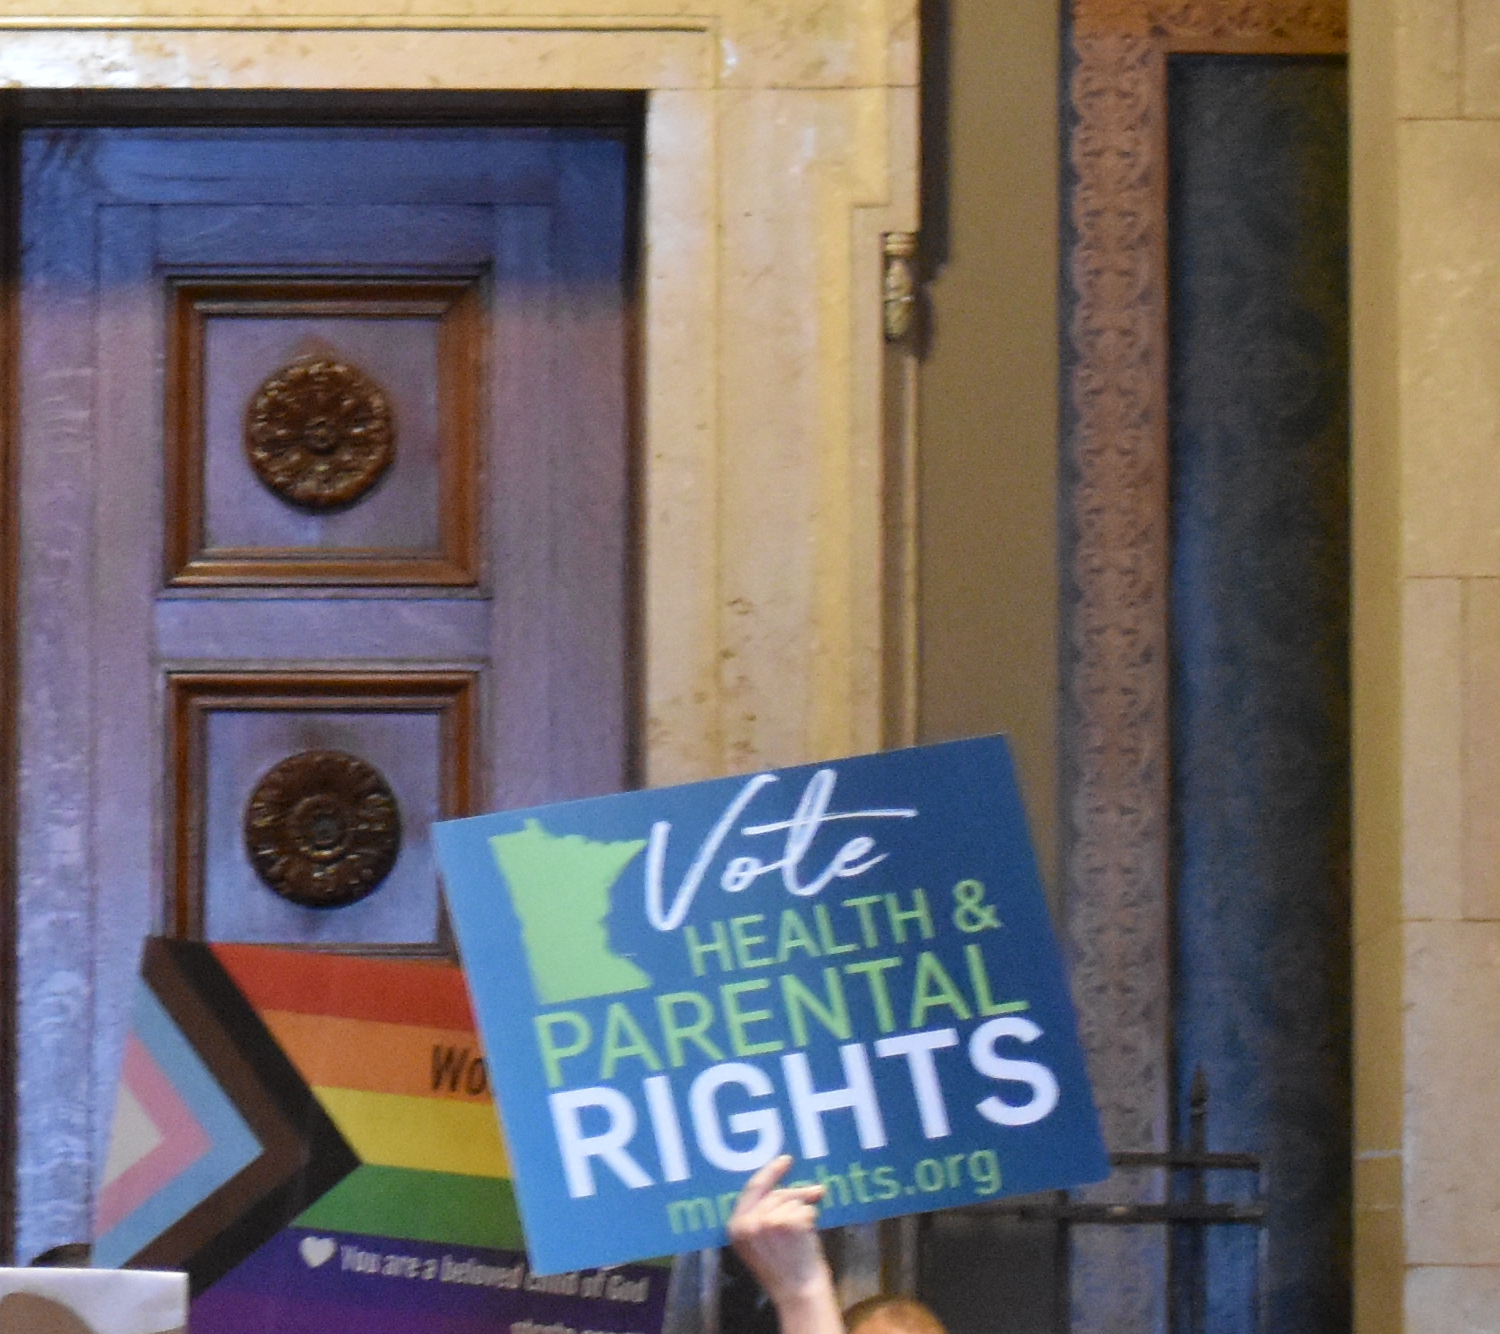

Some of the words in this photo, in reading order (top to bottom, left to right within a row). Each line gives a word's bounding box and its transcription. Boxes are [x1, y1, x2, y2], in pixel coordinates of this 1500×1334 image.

[644, 768, 918, 932] Vote
[684, 888, 937, 977] HEALTH
[952, 878, 1002, 934] &
[534, 944, 1031, 1088] PARENTAL
[549, 1016, 1061, 1200] RIGHTS
